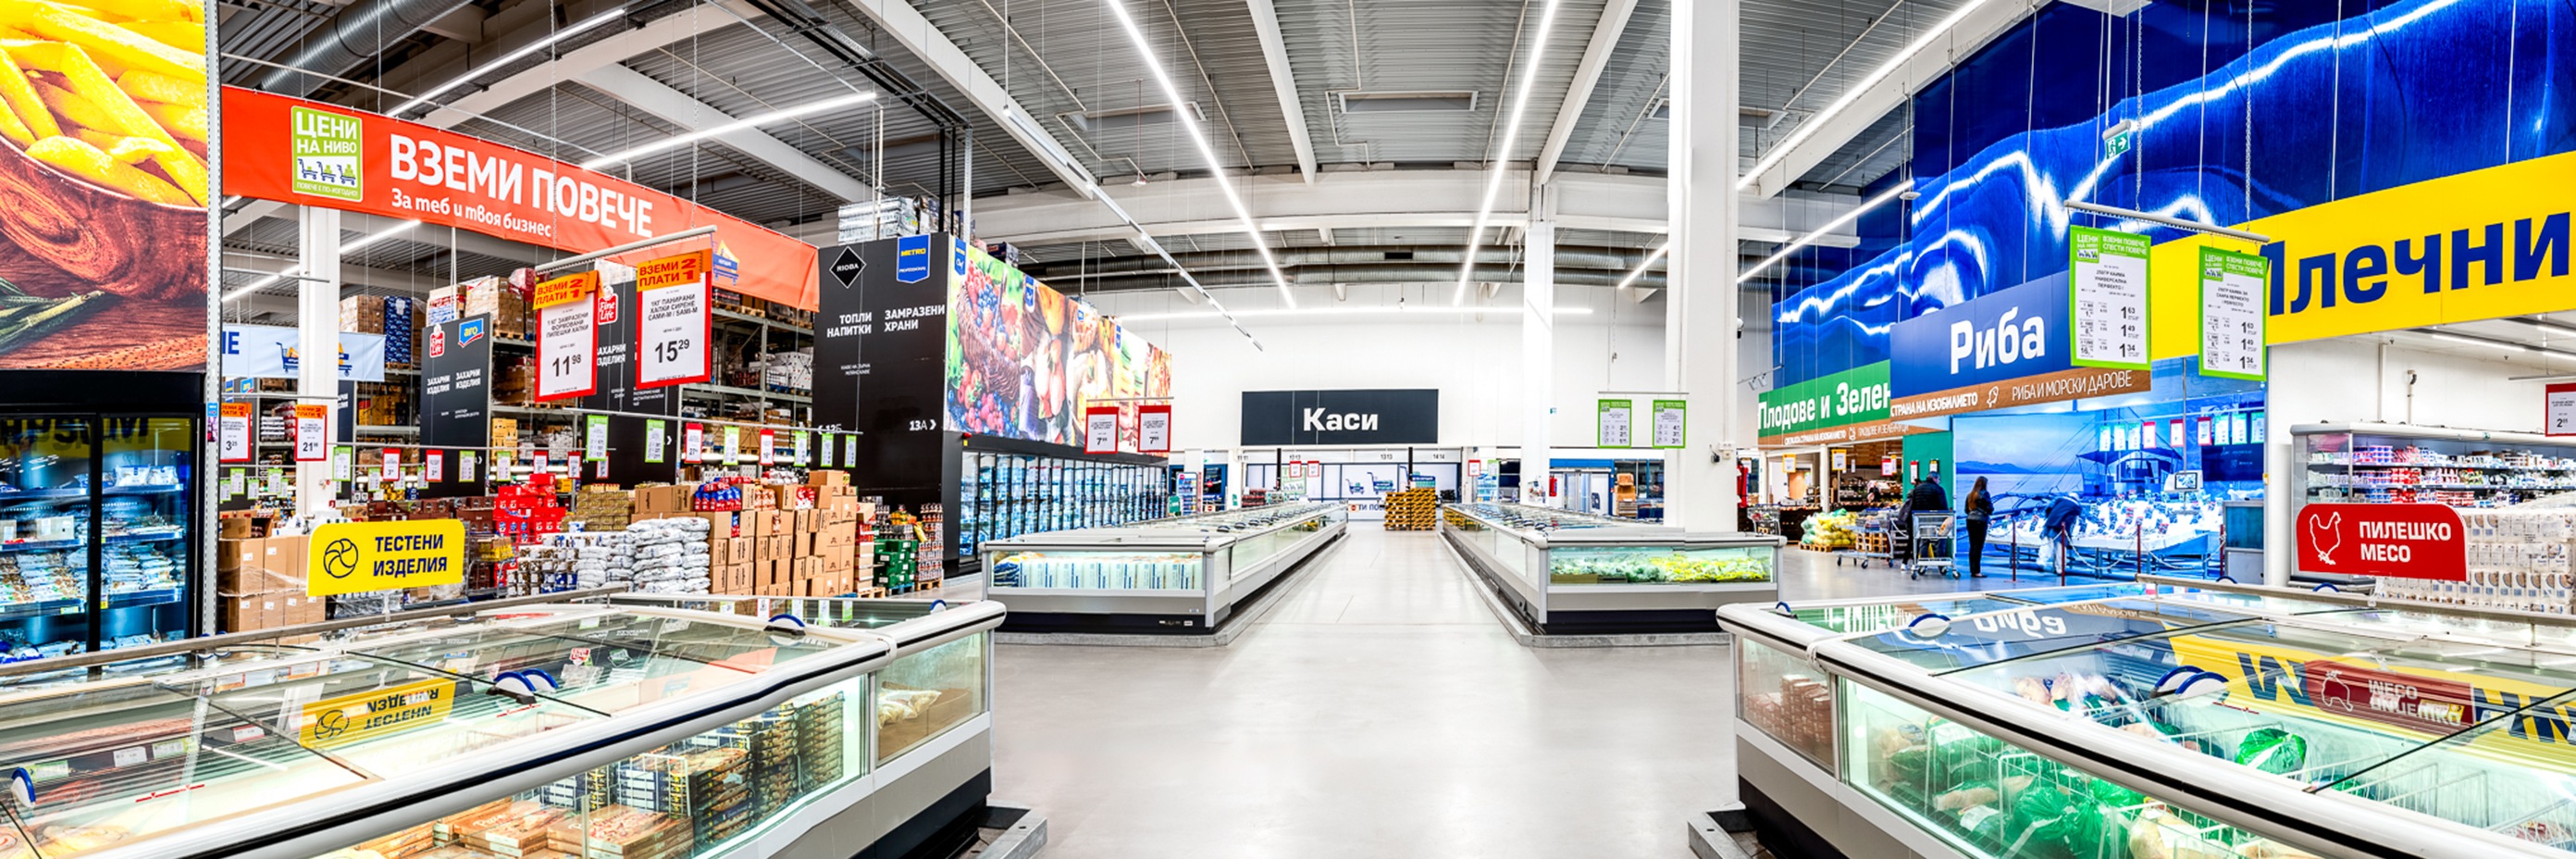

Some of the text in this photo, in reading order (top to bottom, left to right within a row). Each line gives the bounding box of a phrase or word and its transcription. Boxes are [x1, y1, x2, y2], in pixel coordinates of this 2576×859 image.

[296, 111, 357, 140] ЦЕНИ
[296, 138, 357, 155] НА НИВО
[390, 133, 653, 238] ВЗЕМИ ПОВЕЧЕ
[391, 187, 552, 238] За теб и твоя бизнес
[2076, 233, 2099, 243] ЦЕНИ
[900, 247, 927, 257] METRO
[639, 258, 696, 276] ВЗЕМИ 2
[836, 263, 860, 272] RIOBA
[639, 270, 694, 287] ПЛАТИ 1
[537, 279, 584, 295] ВЗЕМИ 2
[535, 289, 580, 305] ПЛАТИ 1
[600, 301, 615, 311] Fine
[885, 305, 946, 320] ЗАМРАЗЕНИ
[600, 309, 614, 321] Life
[839, 312, 873, 325] ТОПЛИ
[464, 327, 478, 337] aro
[827, 324, 873, 338] НАПИТКИ
[884, 319, 919, 332] ХРАНИ
[1950, 306, 2046, 375] Риба
[597, 343, 626, 355] АХАРНИ
[597, 354, 625, 367] ЗДЕЛИЯ
[427, 375, 451, 386] ЗАХАРНИ
[456, 368, 481, 380] ЗАХАРНИ
[427, 384, 450, 395] ИЗДЕЛИЯ
[455, 378, 481, 390] ИЗДЕЛИЯ
[2012, 369, 2132, 402] РИБА И МОРСКИ ДАРОВЕ
[1758, 398, 1815, 430] Плодове
[1820, 394, 1830, 419] и
[1890, 392, 1978, 417] СТРАНА НА ИЗОБИЛИЕТО
[1303, 407, 1379, 432] Каси
[2359, 520, 2452, 542] ПИЛЕШКО
[375, 534, 444, 554] ТЕСТЕНИ
[2359, 543, 2411, 563] МЕСО
[373, 556, 447, 579] ИЗДЕЛИЯ
